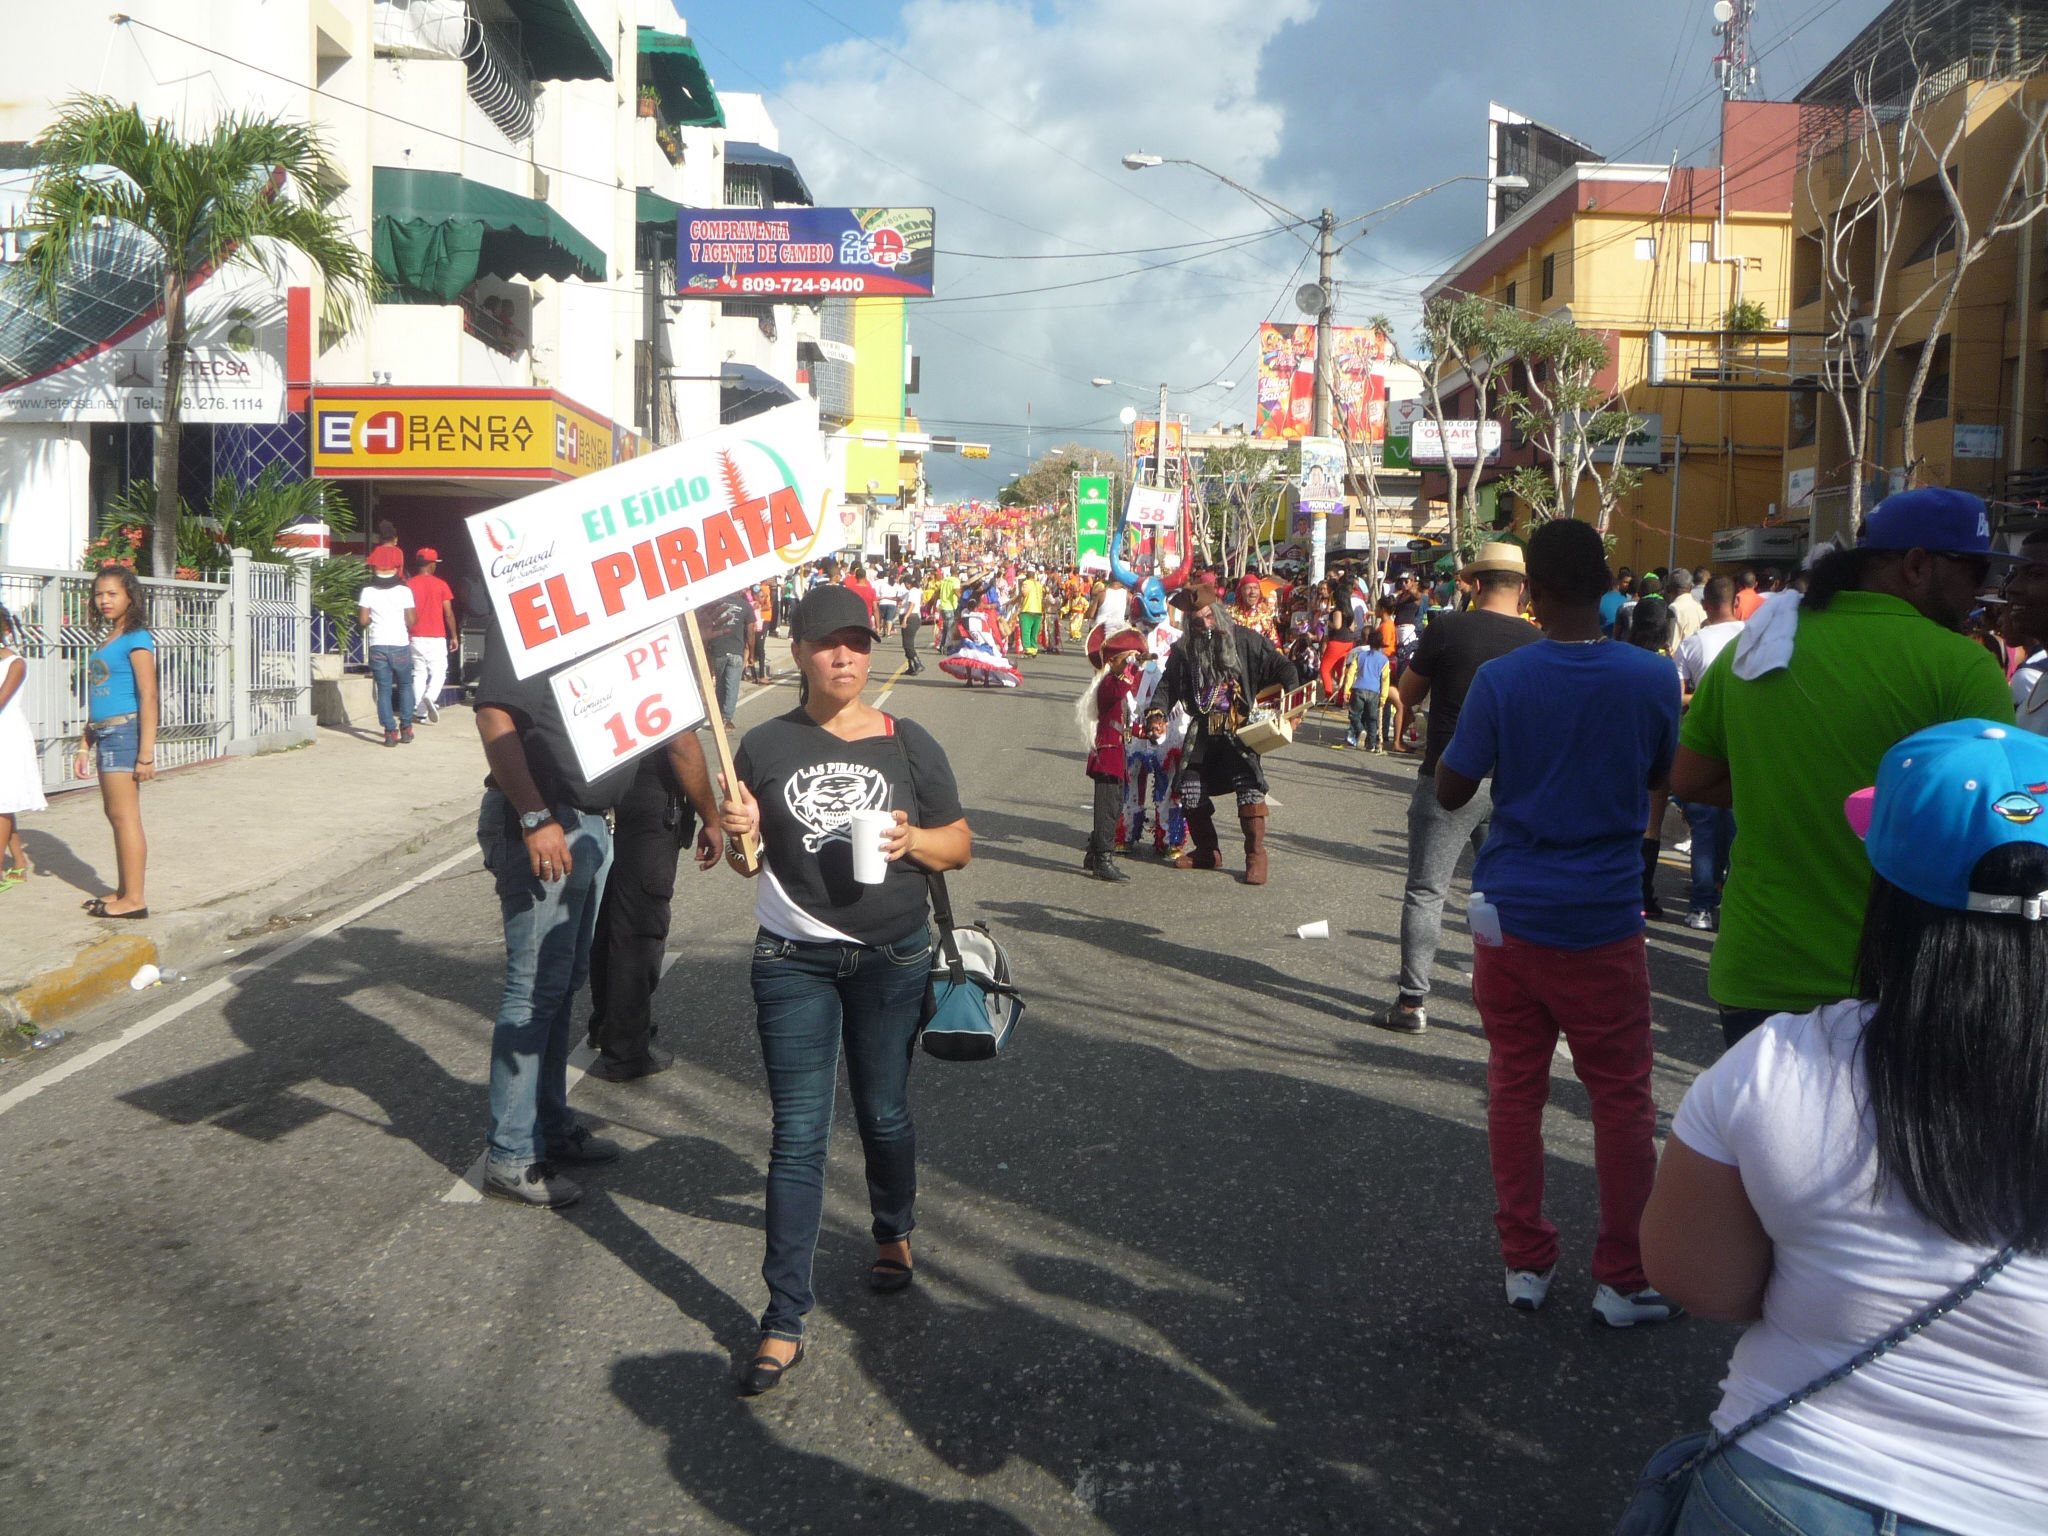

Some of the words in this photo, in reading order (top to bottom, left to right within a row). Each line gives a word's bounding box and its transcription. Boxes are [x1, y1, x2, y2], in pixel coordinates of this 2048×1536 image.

[690, 221, 790, 240] COMPRAVENTA
[842, 230, 876, 249] 24
[690, 244, 702, 262] Y
[702, 244, 754, 262] AGENTE
[757, 244, 777, 262] DE
[779, 244, 834, 263] CAMBIO
[841, 249, 911, 264] Horas
[742, 277, 865, 292] 809-724-9400
[8, 397, 119, 410] www.retecsa.net
[409, 415, 533, 433] BANCA
[409, 434, 535, 451] HENRY
[579, 429, 608, 455] BANCA
[581, 504, 617, 543] El
[621, 475, 711, 528] Ejido
[1139, 507, 1165, 522] 58
[491, 540, 555, 578] Carnaval
[508, 573, 591, 650] EL
[591, 486, 815, 617] PIRATA
[624, 634, 670, 681] PF
[604, 693, 672, 757] 16
[798, 763, 825, 779] LAS
[826, 762, 879, 778] PIRATAS
